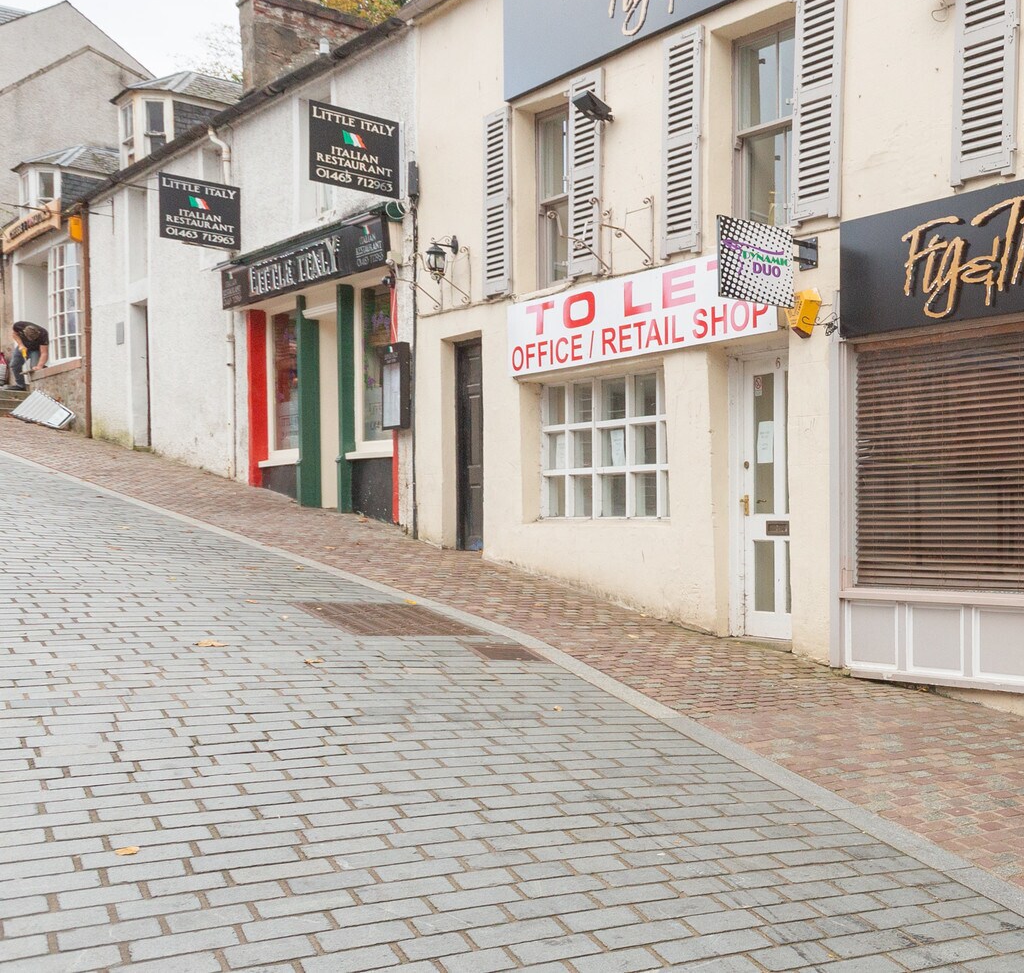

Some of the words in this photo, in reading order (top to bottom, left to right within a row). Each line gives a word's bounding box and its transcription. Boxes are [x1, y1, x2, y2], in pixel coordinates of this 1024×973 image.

[312, 105, 355, 127] LITTLE
[360, 121, 395, 137] ITALY
[331, 145, 379, 164] ITALIAN
[316, 152, 393, 177] RESTAURANT
[162, 177, 200, 193] LITTLE
[205, 187, 237, 200] ITALY
[356, 176, 393, 192] 712963
[165, 214, 235, 233] RESTAURANT
[179, 208, 222, 223] ITALIAN
[165, 227, 198, 239] 01463
[202, 233, 235, 245] 712963
[249, 260, 297, 296] LITTLE
[296, 235, 340, 283] ITALY
[742, 250, 790, 268] DYNAMIC
[901, 215, 964, 319] Fig
[752, 261, 781, 278] DUO
[526, 290, 595, 336] TO
[624, 259, 718, 318] LE
[511, 334, 583, 372] OFFICE
[602, 314, 685, 354] RETAIL
[692, 299, 769, 340] SHOP
[775, 357, 781, 369] 6
